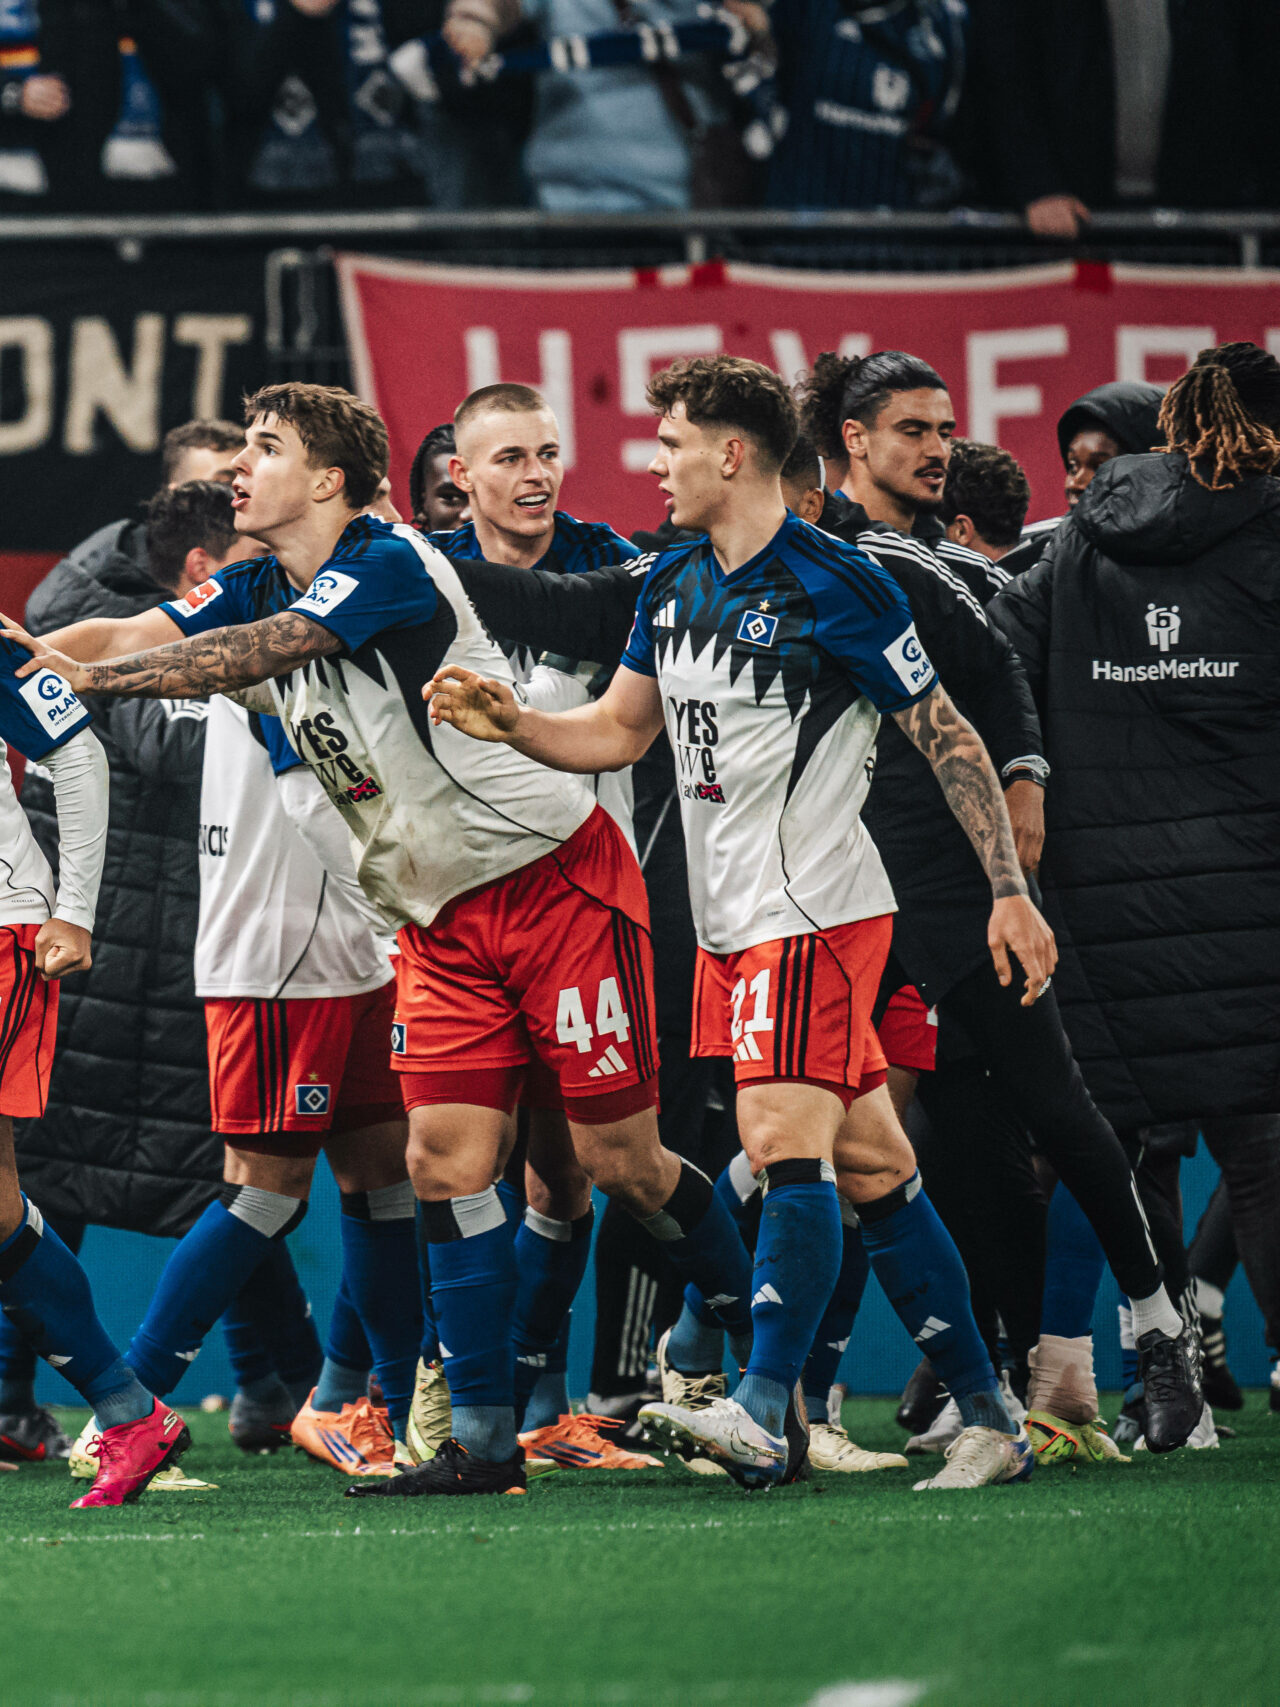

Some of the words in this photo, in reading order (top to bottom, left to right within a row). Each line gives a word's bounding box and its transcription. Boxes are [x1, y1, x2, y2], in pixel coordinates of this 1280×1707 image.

[910, 658, 930, 684] PLA
[1092, 657, 1240, 683] HanseMerkur
[289, 711, 349, 762] YES
[668, 696, 720, 748] YES
[677, 743, 718, 784] We
[556, 976, 630, 1054] 44
[730, 968, 774, 1043] 21
